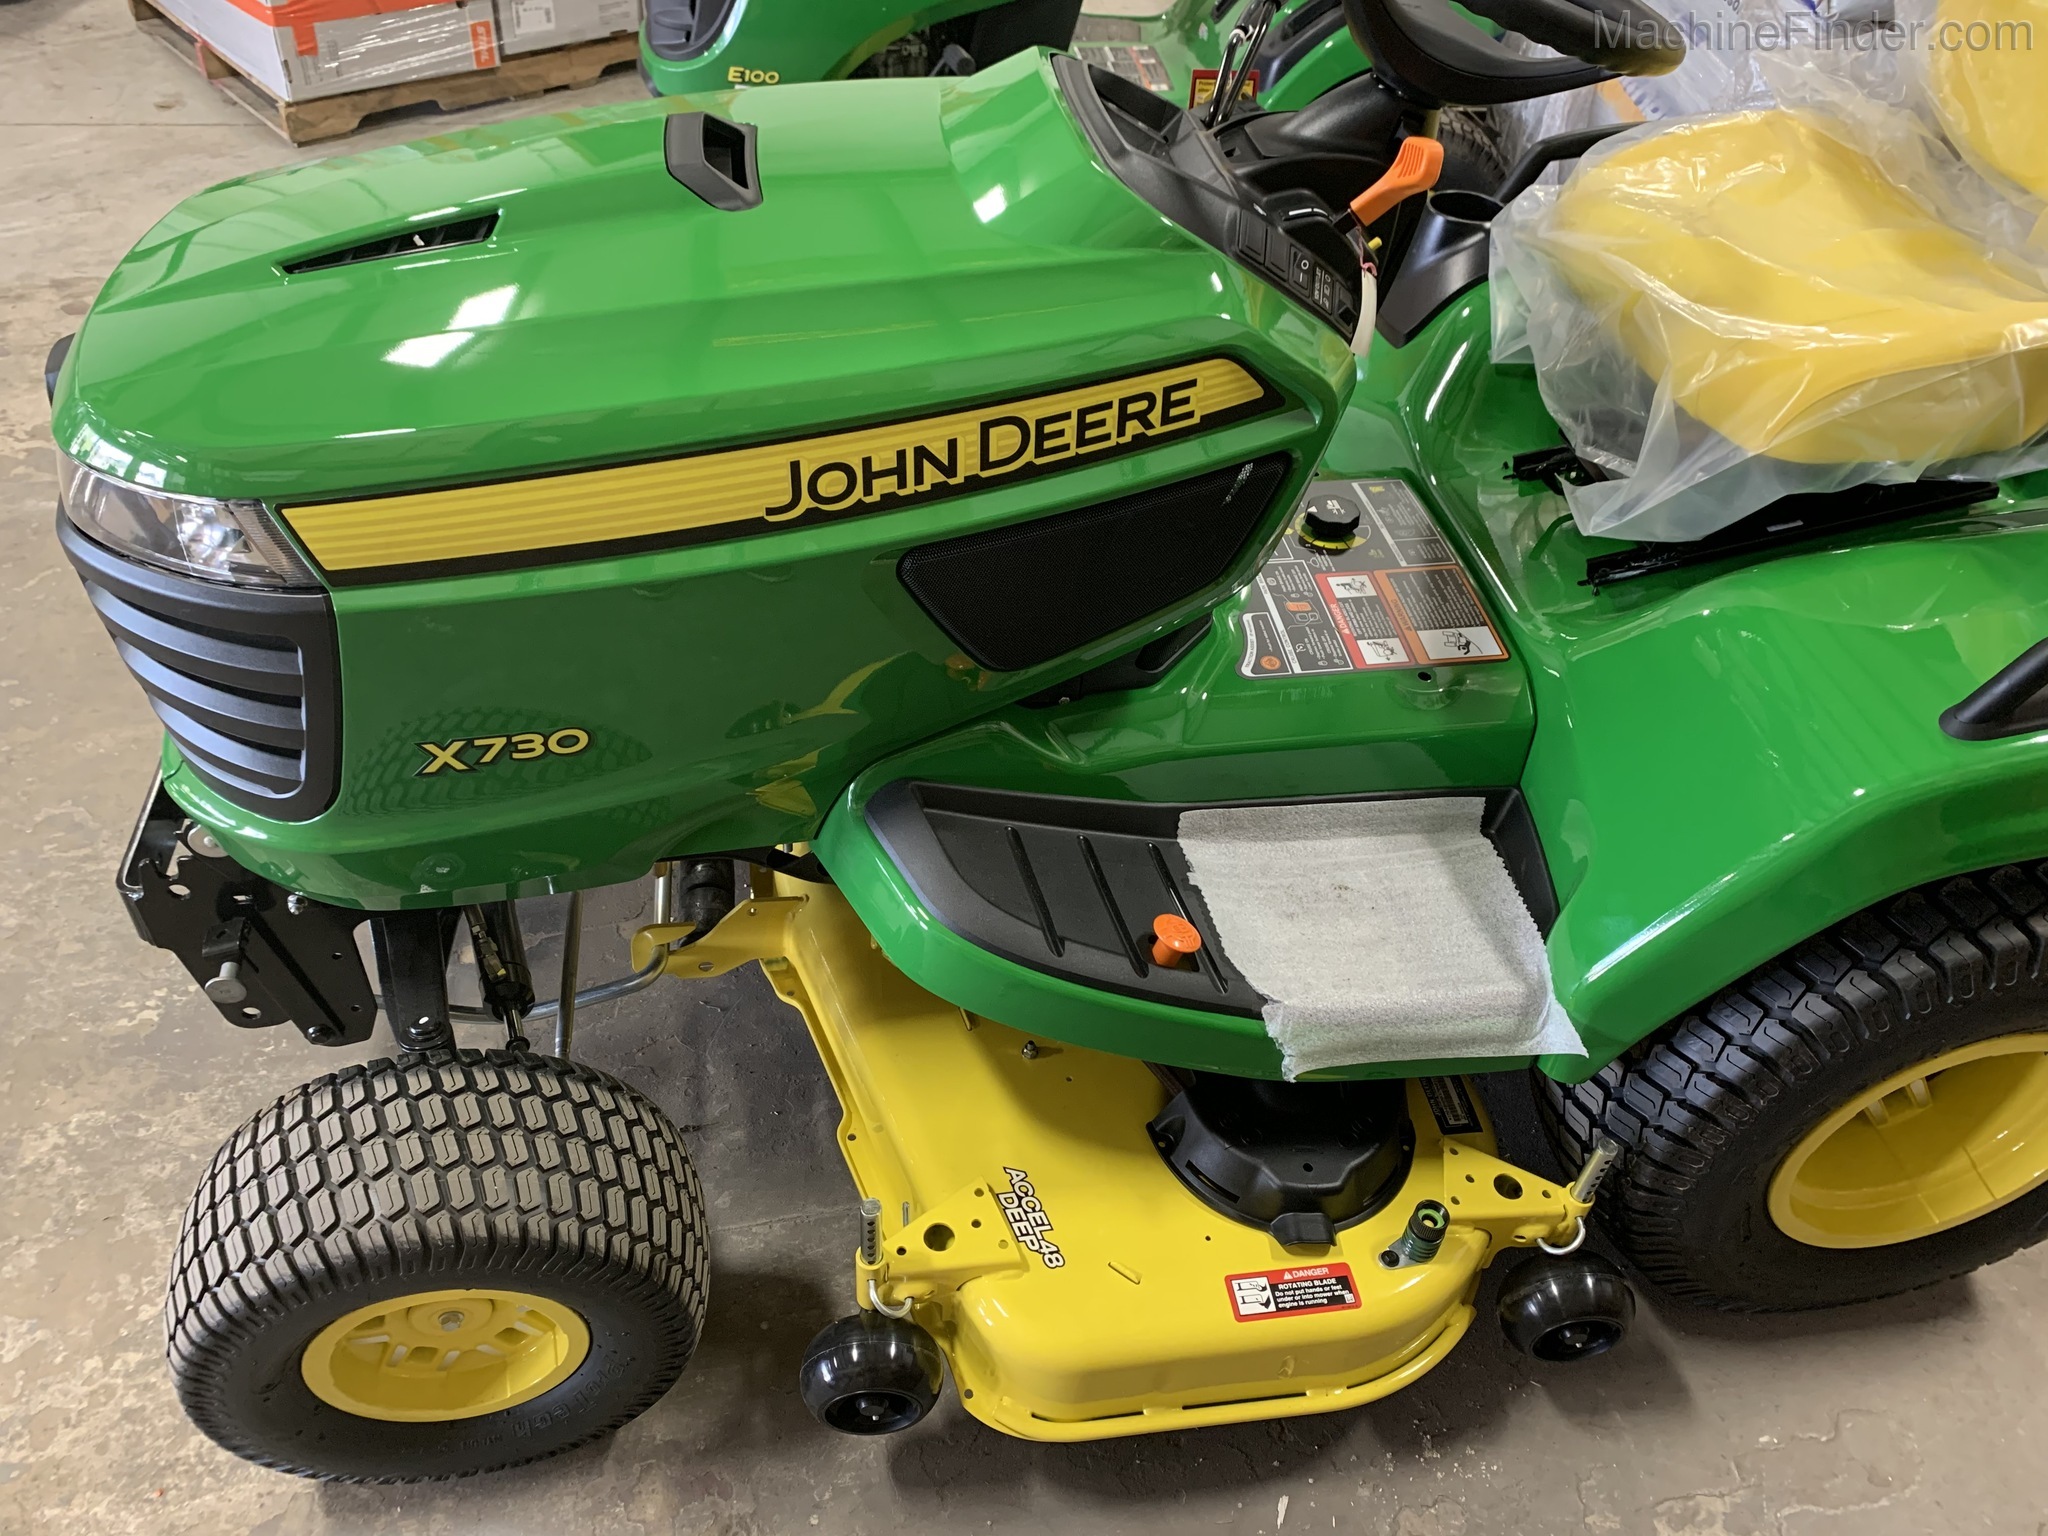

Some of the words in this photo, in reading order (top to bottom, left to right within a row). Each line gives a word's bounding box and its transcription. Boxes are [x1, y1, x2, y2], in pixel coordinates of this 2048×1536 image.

[727, 66, 780, 84] E100
[764, 437, 958, 517] JOHN
[979, 377, 1198, 473] DEERE
[1329, 603, 1348, 629] DANGER
[1390, 598, 1410, 627] WARNING
[416, 728, 590, 775] X730
[996, 1191, 1041, 1252] DEEP
[1278, 1281, 1313, 1290] ROTATING
[1314, 1278, 1337, 1287] BLADE
[1292, 1267, 1329, 1278] DANGER
[1278, 1301, 1298, 1309] engine
